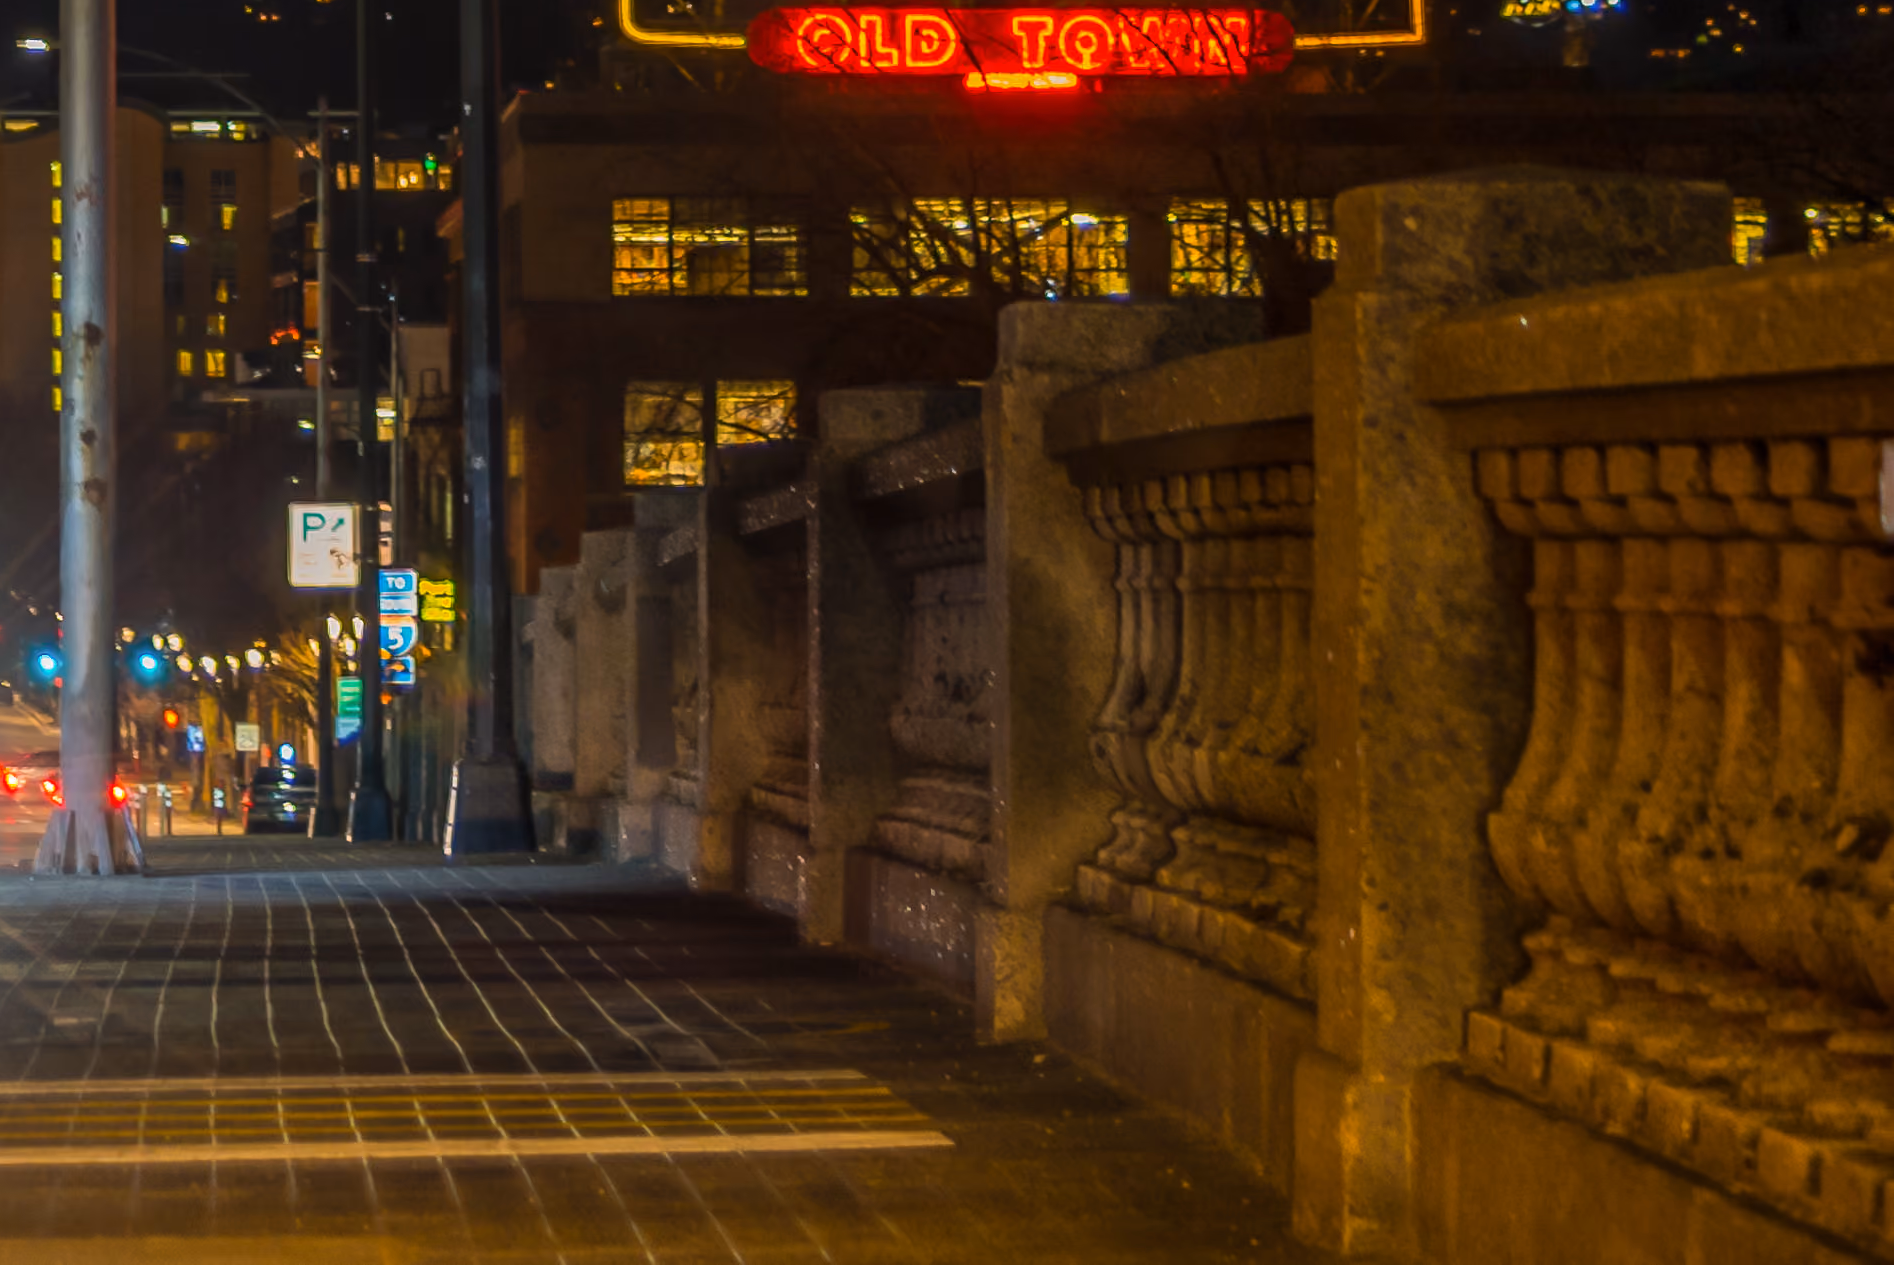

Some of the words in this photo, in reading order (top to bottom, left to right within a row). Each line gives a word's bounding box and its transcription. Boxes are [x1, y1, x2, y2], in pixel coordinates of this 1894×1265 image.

[796, 13, 957, 69] OLD
[1011, 14, 1248, 71] TOWN
[303, 512, 326, 543] P
[386, 577, 406, 590] TO
[388, 626, 404, 650] 5
